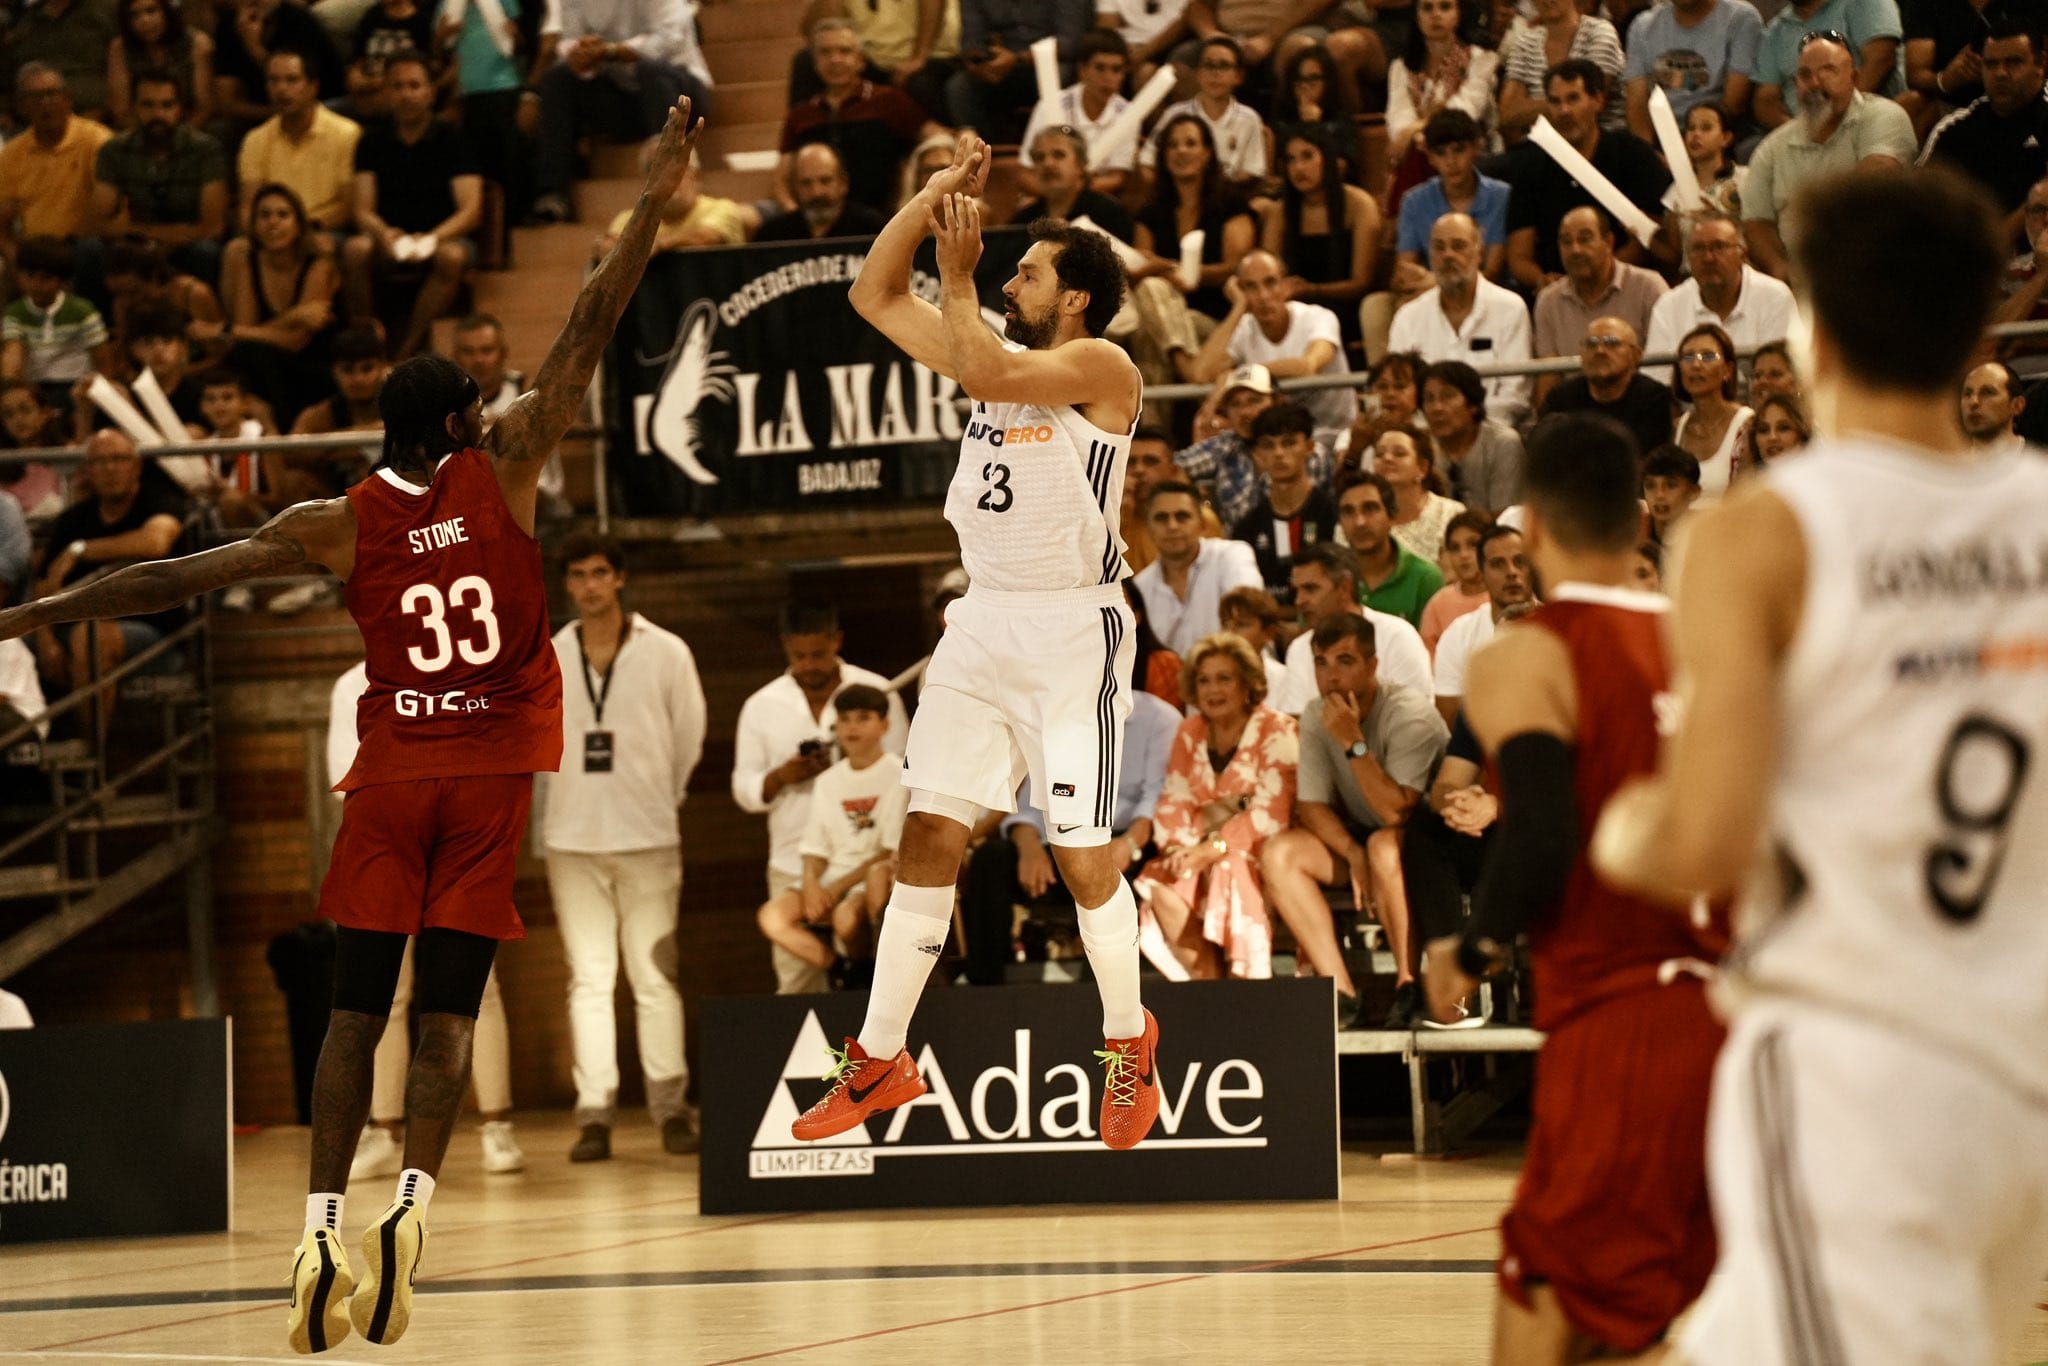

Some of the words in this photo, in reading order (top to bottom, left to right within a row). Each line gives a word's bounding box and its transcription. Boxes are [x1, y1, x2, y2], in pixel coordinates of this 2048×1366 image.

[734, 369, 814, 457] LA
[825, 361, 964, 449] MAR
[799, 458, 882, 494] BADAJOZ
[977, 461, 1014, 513] 23
[408, 516, 469, 554] STONE
[401, 575, 501, 673] 33
[1924, 712, 2032, 928] 9
[883, 1028, 1264, 1143] Adave
[755, 1150, 871, 1173] LIMPIEZAS
